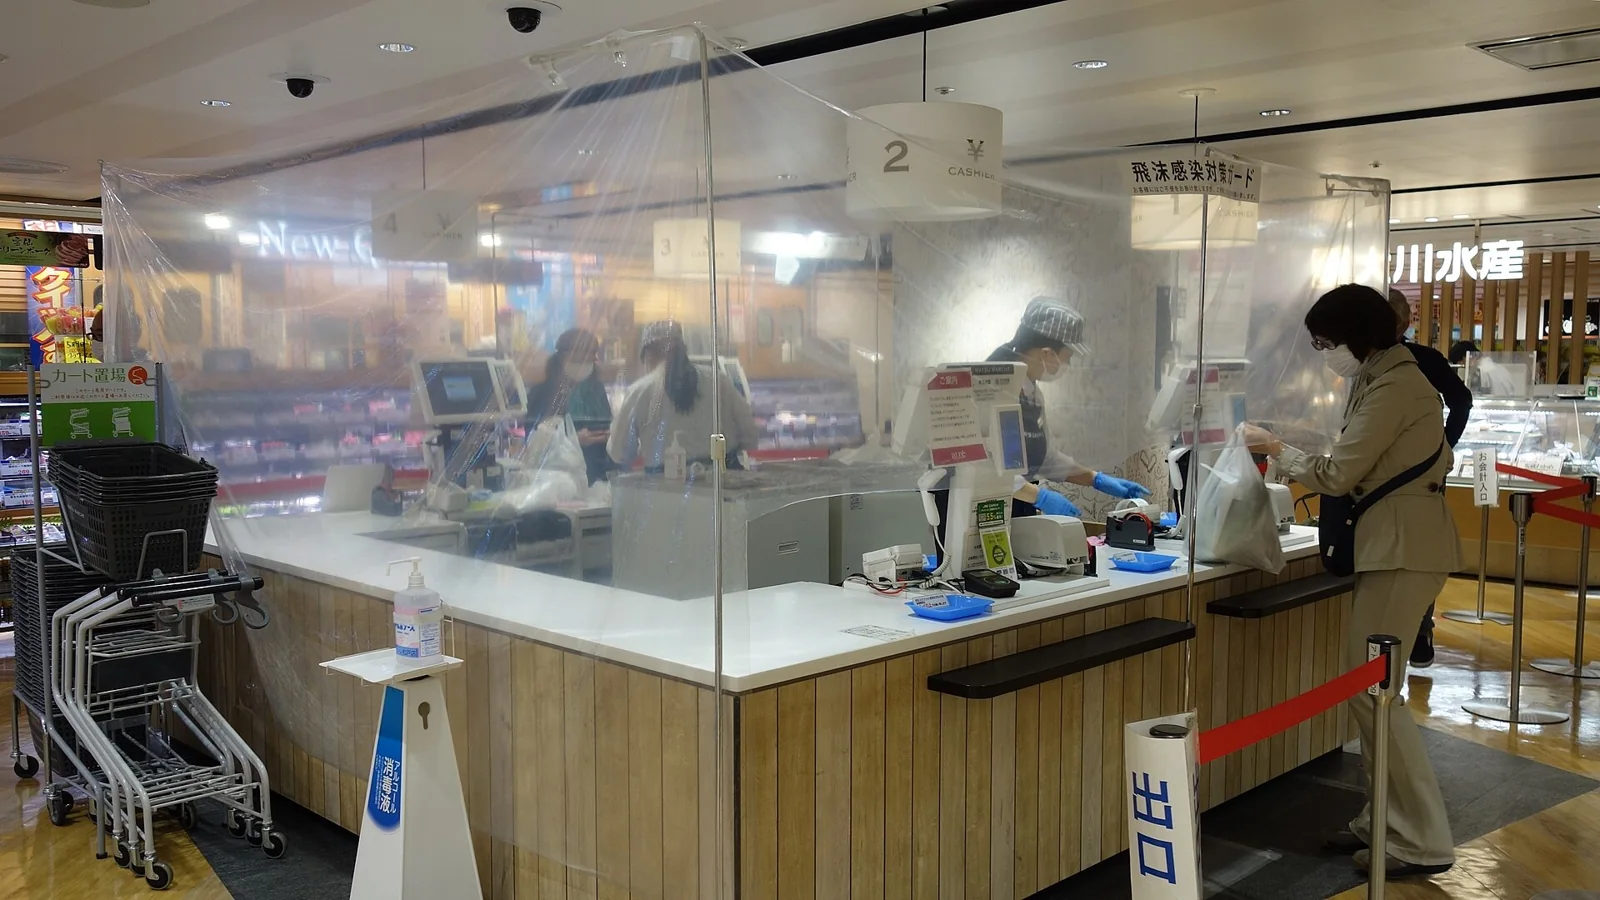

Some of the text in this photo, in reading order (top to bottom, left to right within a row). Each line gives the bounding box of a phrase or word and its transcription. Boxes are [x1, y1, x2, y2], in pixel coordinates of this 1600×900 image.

[883, 140, 910, 173] 2
[383, 212, 398, 235] 4
[1388, 240, 1525, 284] 川水産
[52, 368, 126, 384] カート置場
[1478, 452, 1489, 502] お会計入口
[380, 756, 395, 814] 消毒液
[390, 760, 401, 814] アルコール
[1132, 771, 1176, 885] 出口
